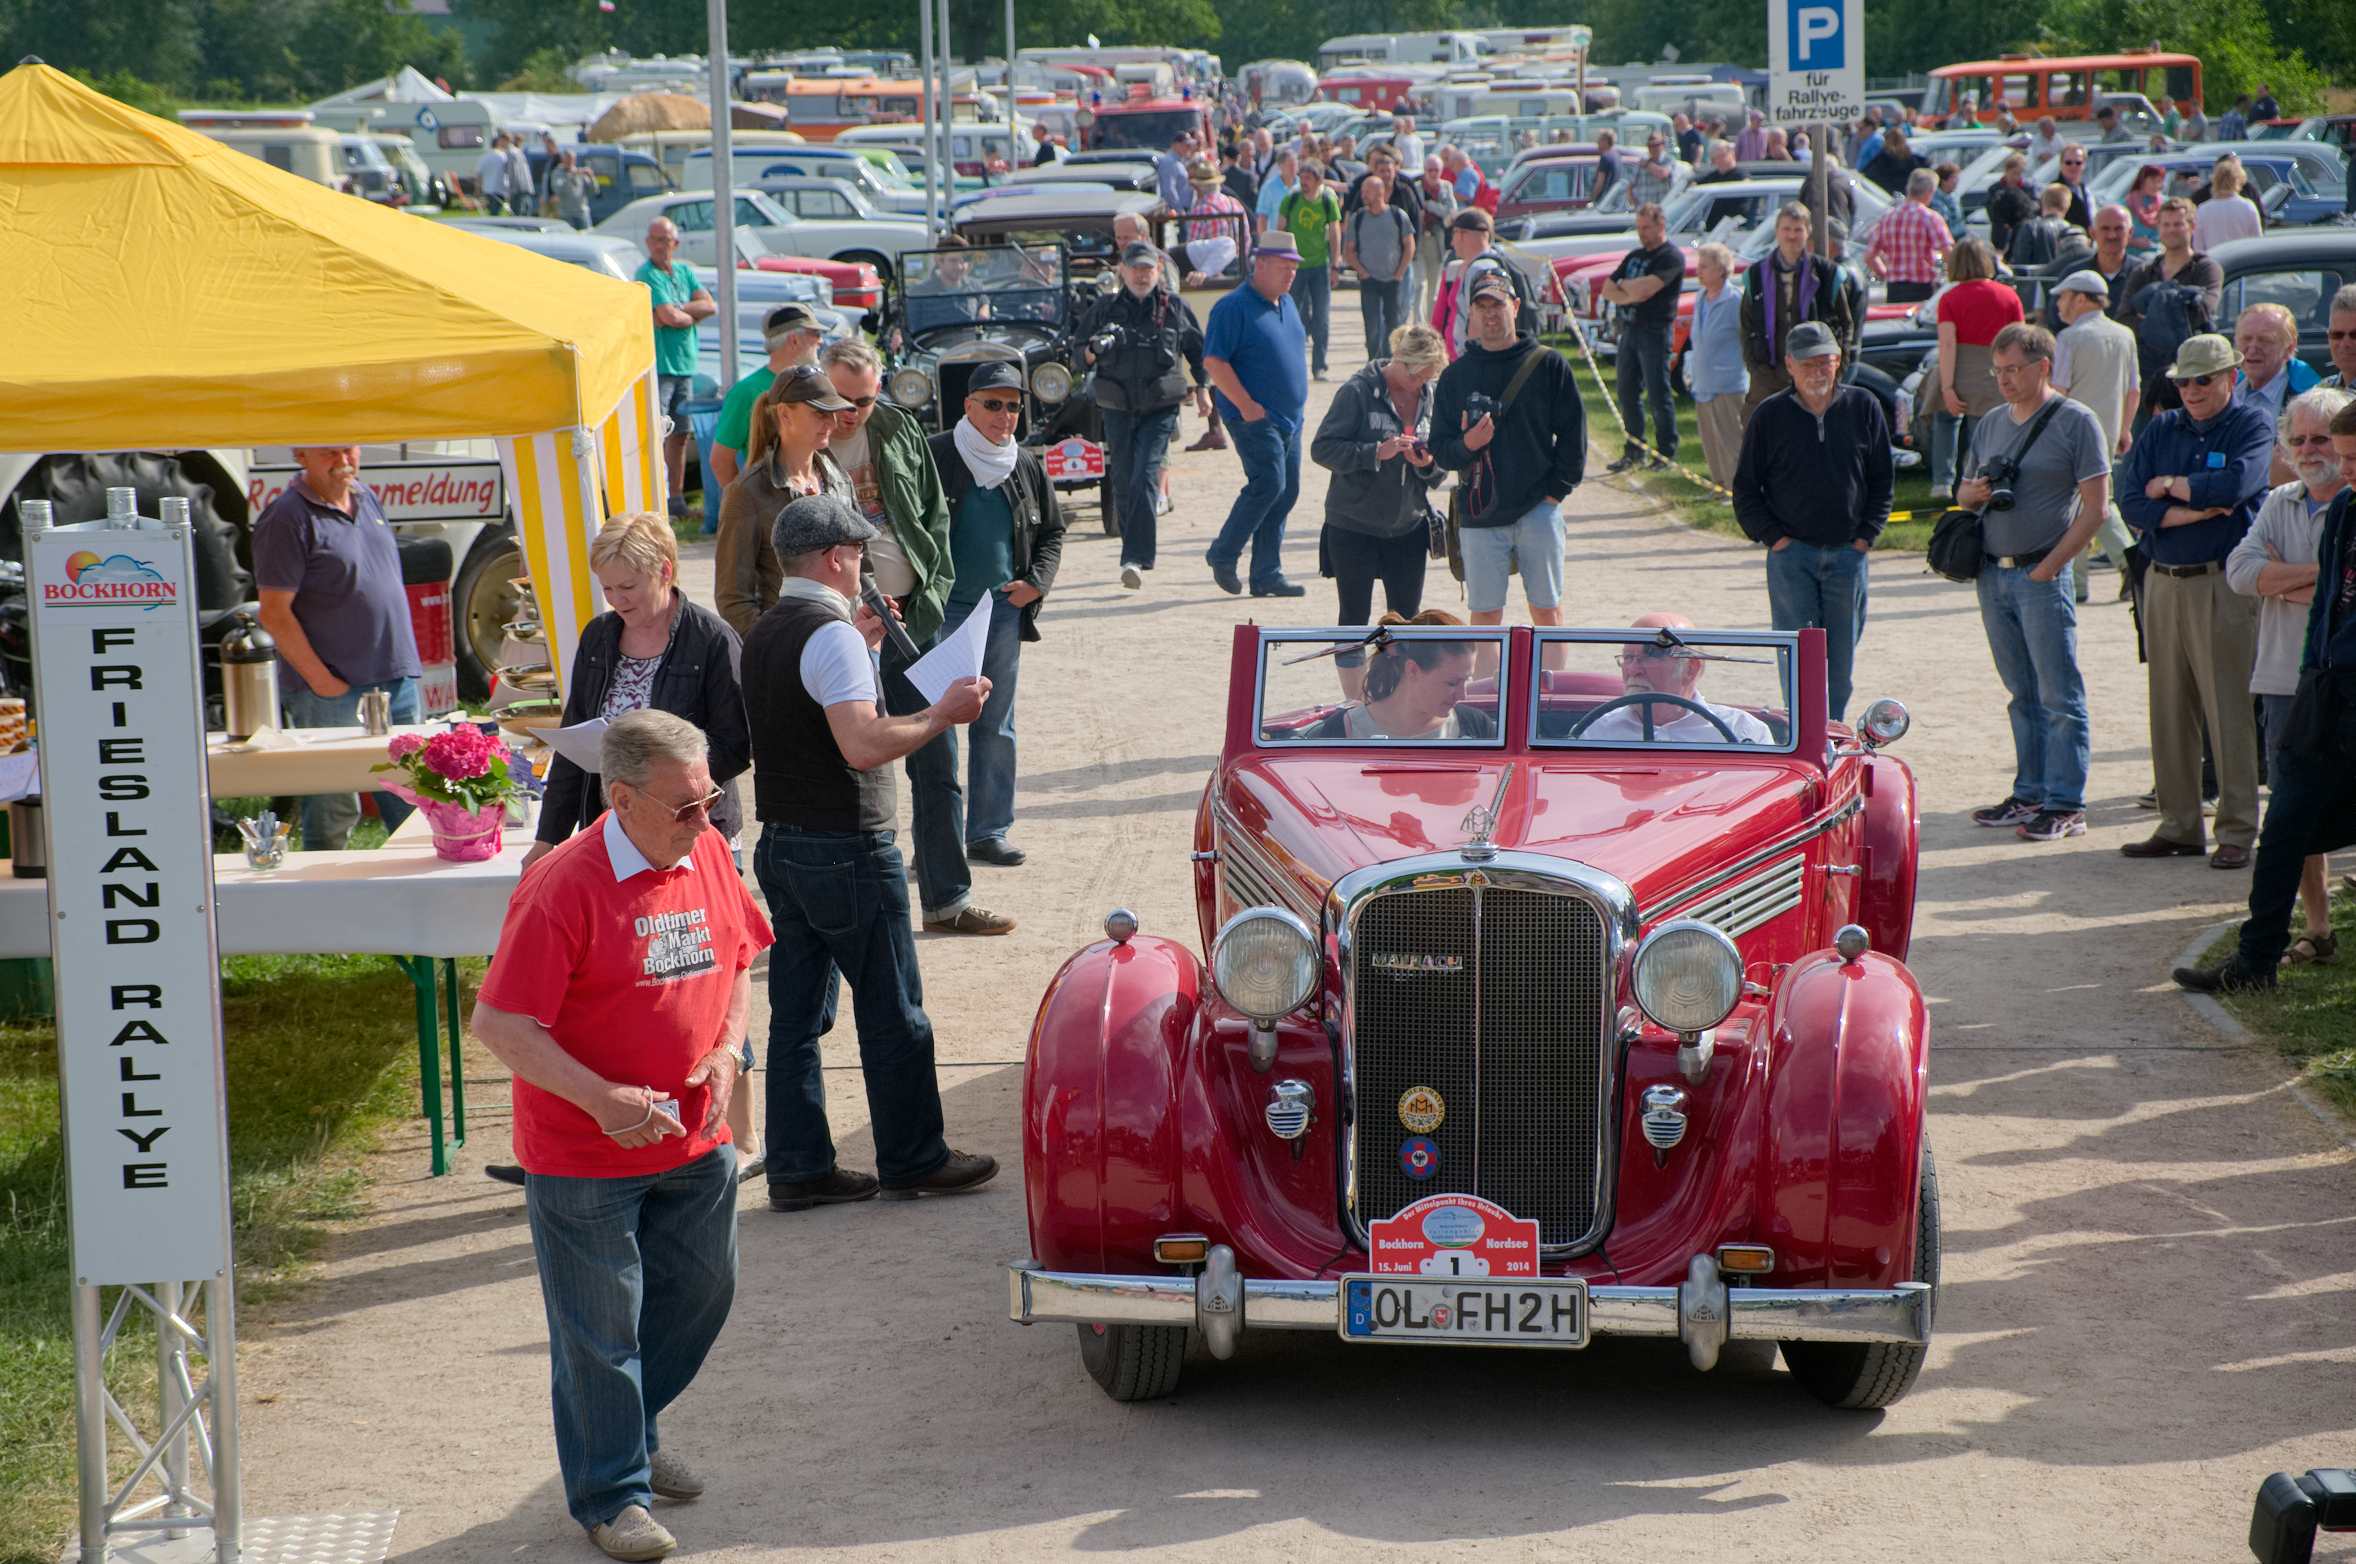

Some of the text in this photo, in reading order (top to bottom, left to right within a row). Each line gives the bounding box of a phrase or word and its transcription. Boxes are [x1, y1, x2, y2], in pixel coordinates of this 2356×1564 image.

[1798, 6, 1839, 60] P
[1806, 71, 1830, 87] für
[1776, 105, 1860, 120] fahrzeuge
[44, 582, 177, 599] BOCKHORN
[90, 628, 171, 1189] FRIESLAND RALLYE
[634, 907, 707, 938] Oldtimer
[668, 926, 711, 949] Markt
[643, 947, 716, 976] Bockhorn
[1402, 1197, 1504, 1221] Der Mittelpunkt Ihres Urlaubs
[1378, 1237, 1529, 1249] Bockhorn Nordsee
[1378, 1257, 1530, 1275] 15. Juni 1 2014
[1355, 1313, 1365, 1325] D
[1376, 1288, 1429, 1328] OL
